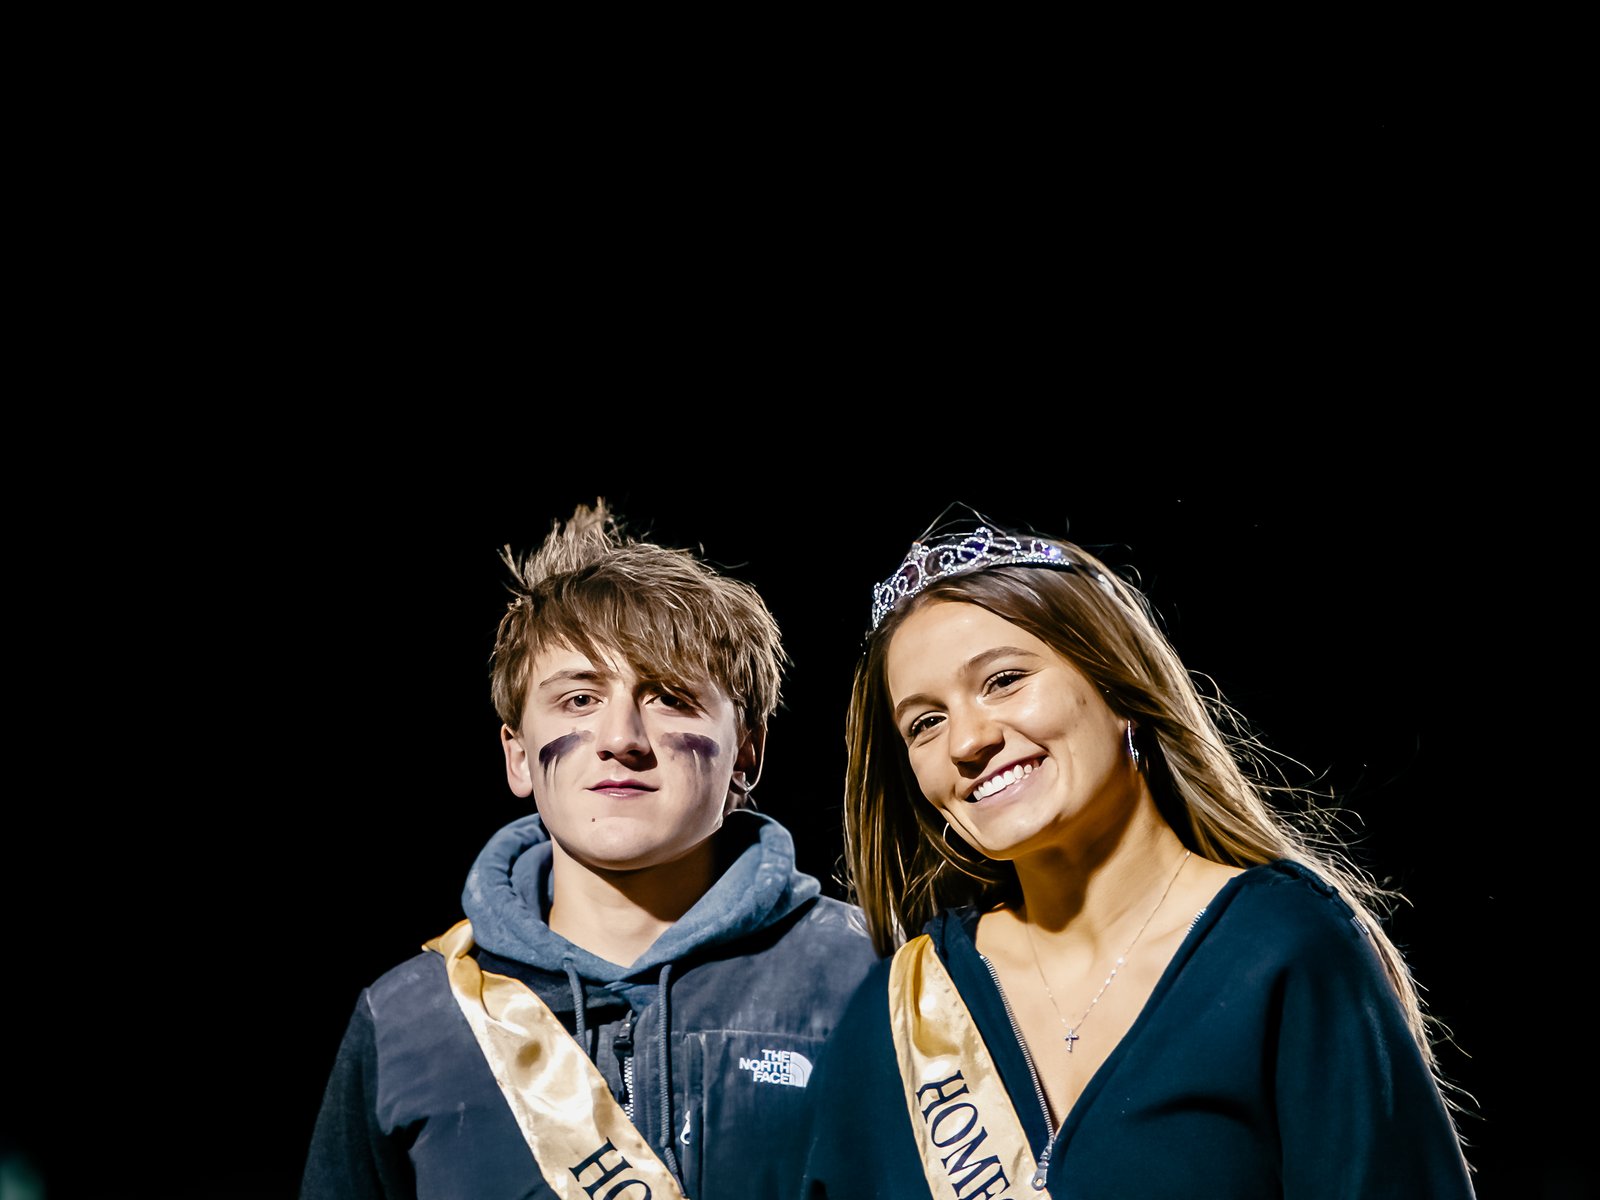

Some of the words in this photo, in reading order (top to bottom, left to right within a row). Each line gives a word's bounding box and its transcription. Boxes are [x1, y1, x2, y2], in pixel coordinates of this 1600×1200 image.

[761, 1049, 790, 1062] THE
[739, 1057, 789, 1074] NORTH
[753, 1070, 790, 1085] FACE
